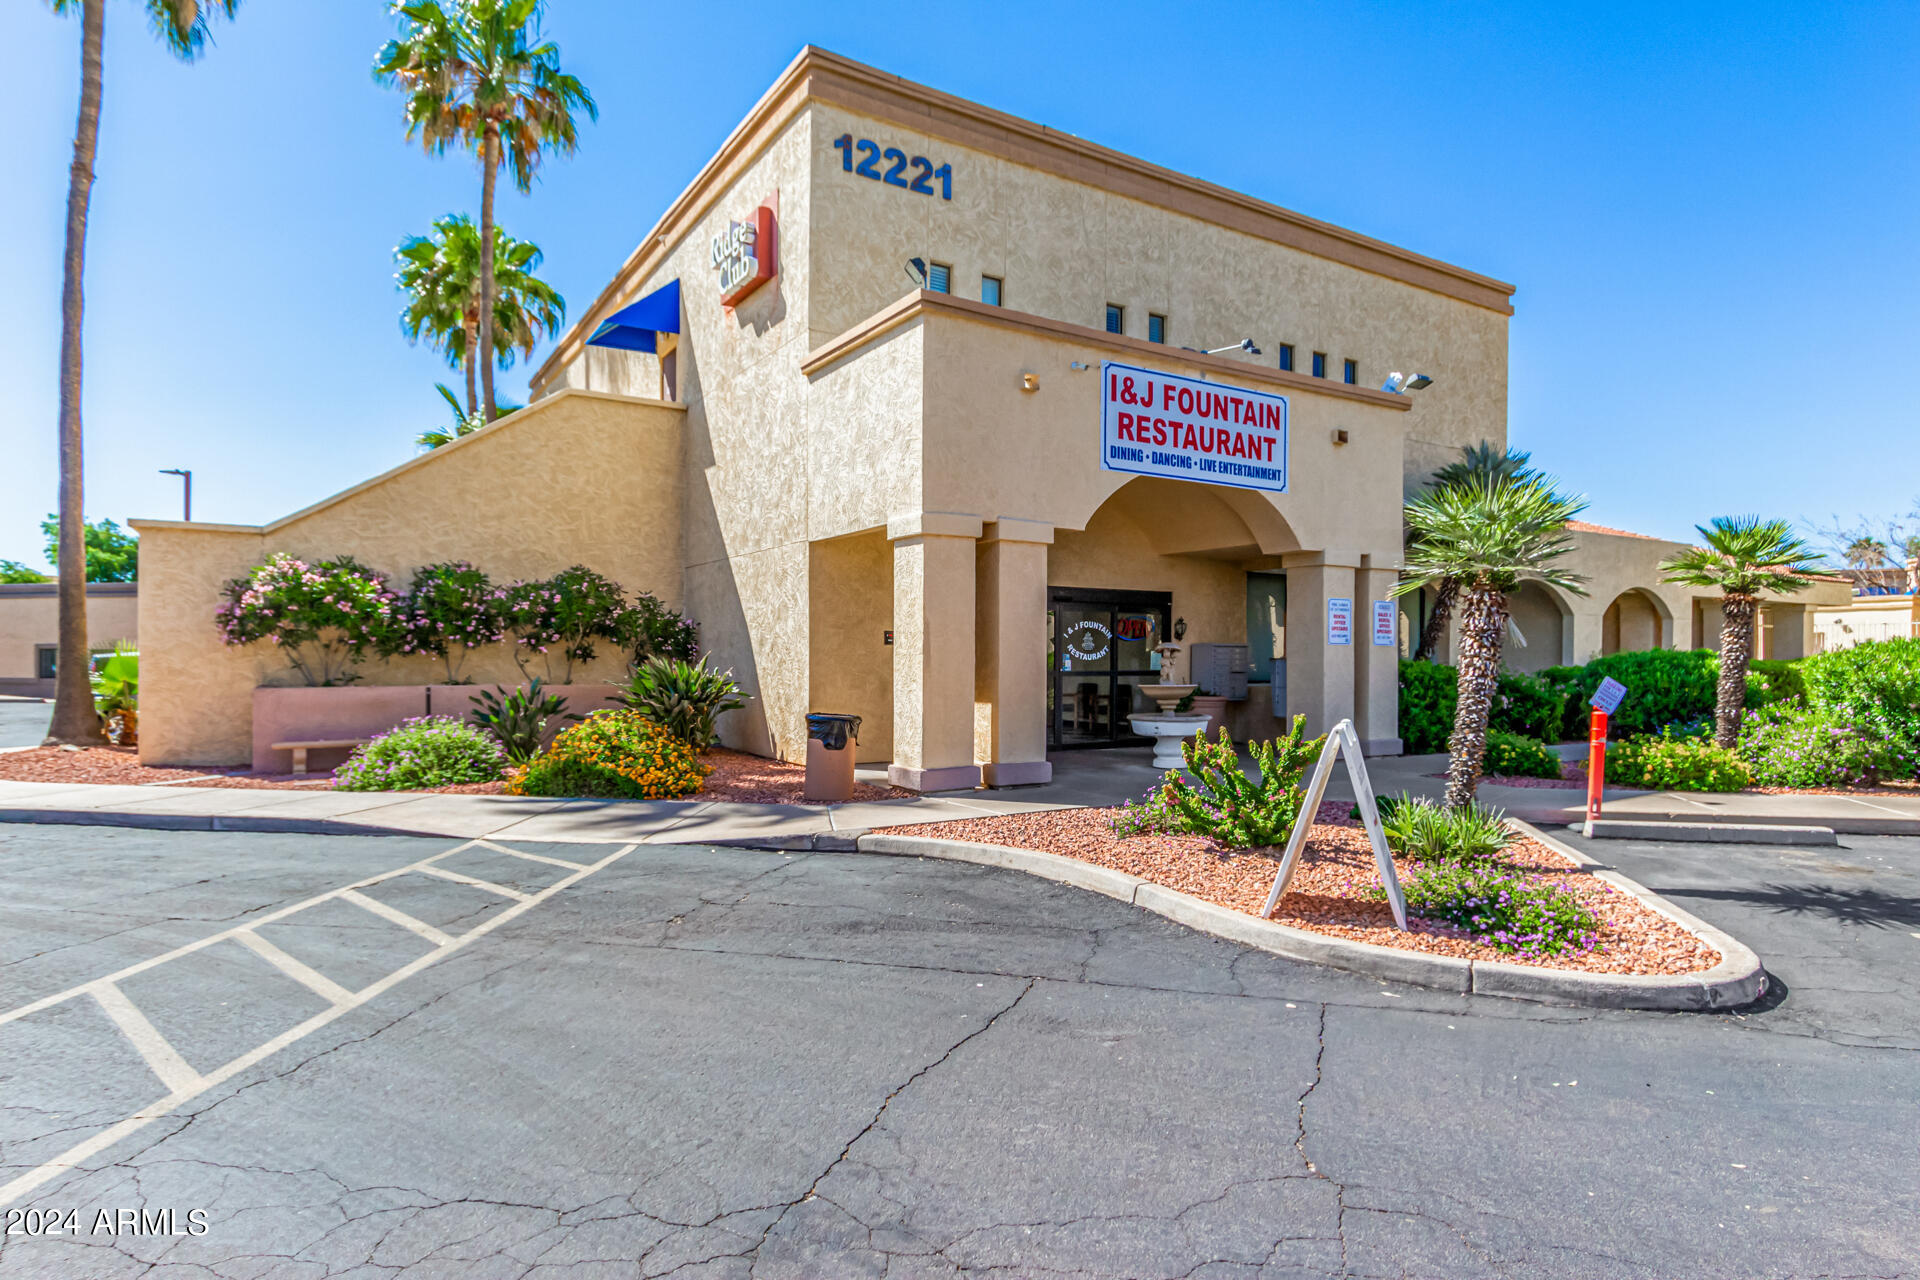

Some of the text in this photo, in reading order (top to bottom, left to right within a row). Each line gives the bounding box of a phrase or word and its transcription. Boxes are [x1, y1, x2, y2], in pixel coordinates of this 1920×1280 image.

[834, 133, 952, 201] 12221
[1110, 373, 1281, 430] I&J FOUNTAIN
[1117, 411, 1277, 462] RESTAURANT
[1110, 445, 1282, 482] DINING DANCING LIVE ENTERTAINMENT
[1067, 643, 1110, 661] RESTAURANT
[1080, 620, 1113, 640] FOUNTAIN
